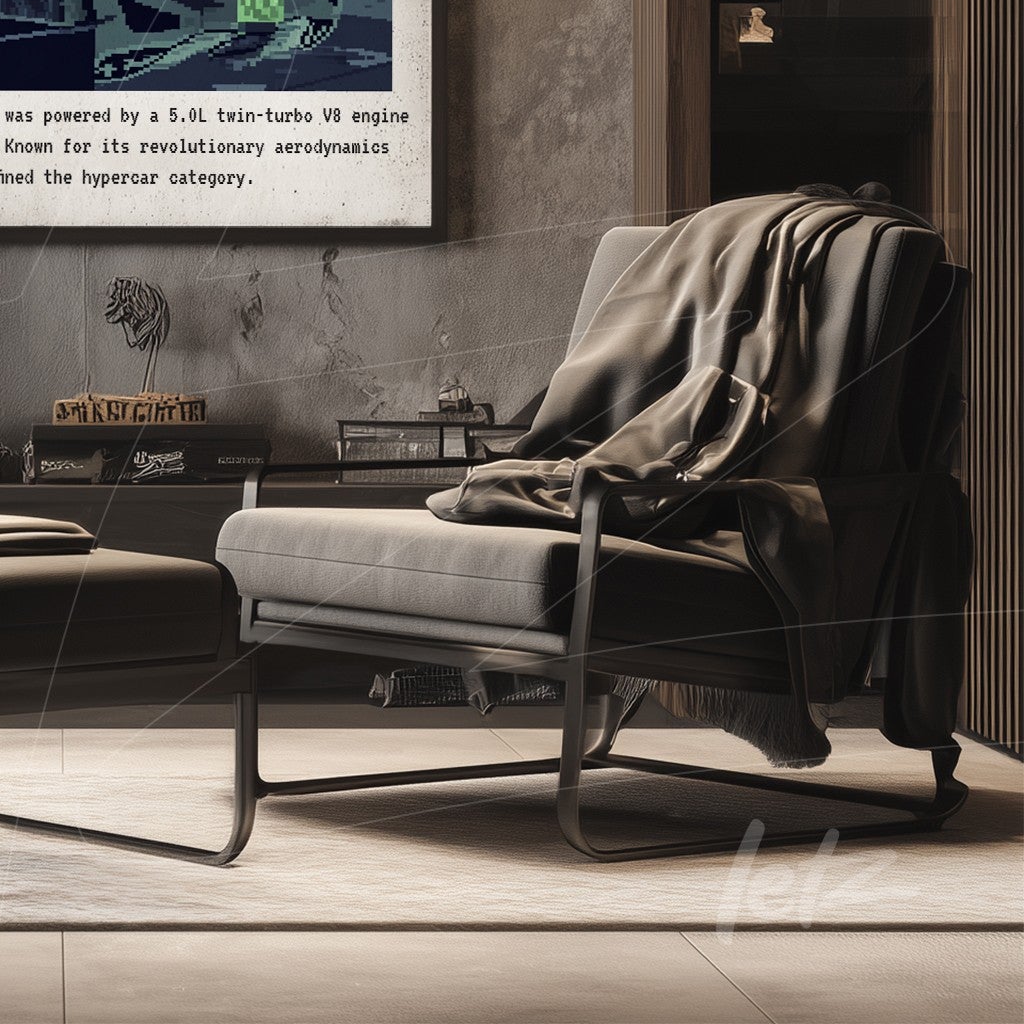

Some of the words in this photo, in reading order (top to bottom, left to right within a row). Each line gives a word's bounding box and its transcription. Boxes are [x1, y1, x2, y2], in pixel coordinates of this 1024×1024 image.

[5, 111, 33, 123] was
[43, 107, 111, 126] powered
[120, 107, 140, 126] by
[150, 111, 159, 123] a
[169, 107, 207, 123] 5.0L
[217, 107, 313, 123] twin-turbo
[323, 107, 341, 123] V8
[351, 107, 409, 127] engine
[5, 138, 53, 154] Known
[63, 138, 92, 154] for
[102, 138, 130, 154] its
[139, 138, 265, 158] revolutionary
[274, 138, 390, 158] aerodynamics
[44, 169, 72, 185] the
[82, 169, 159, 189] hypercar
[169, 169, 254, 189] category.
